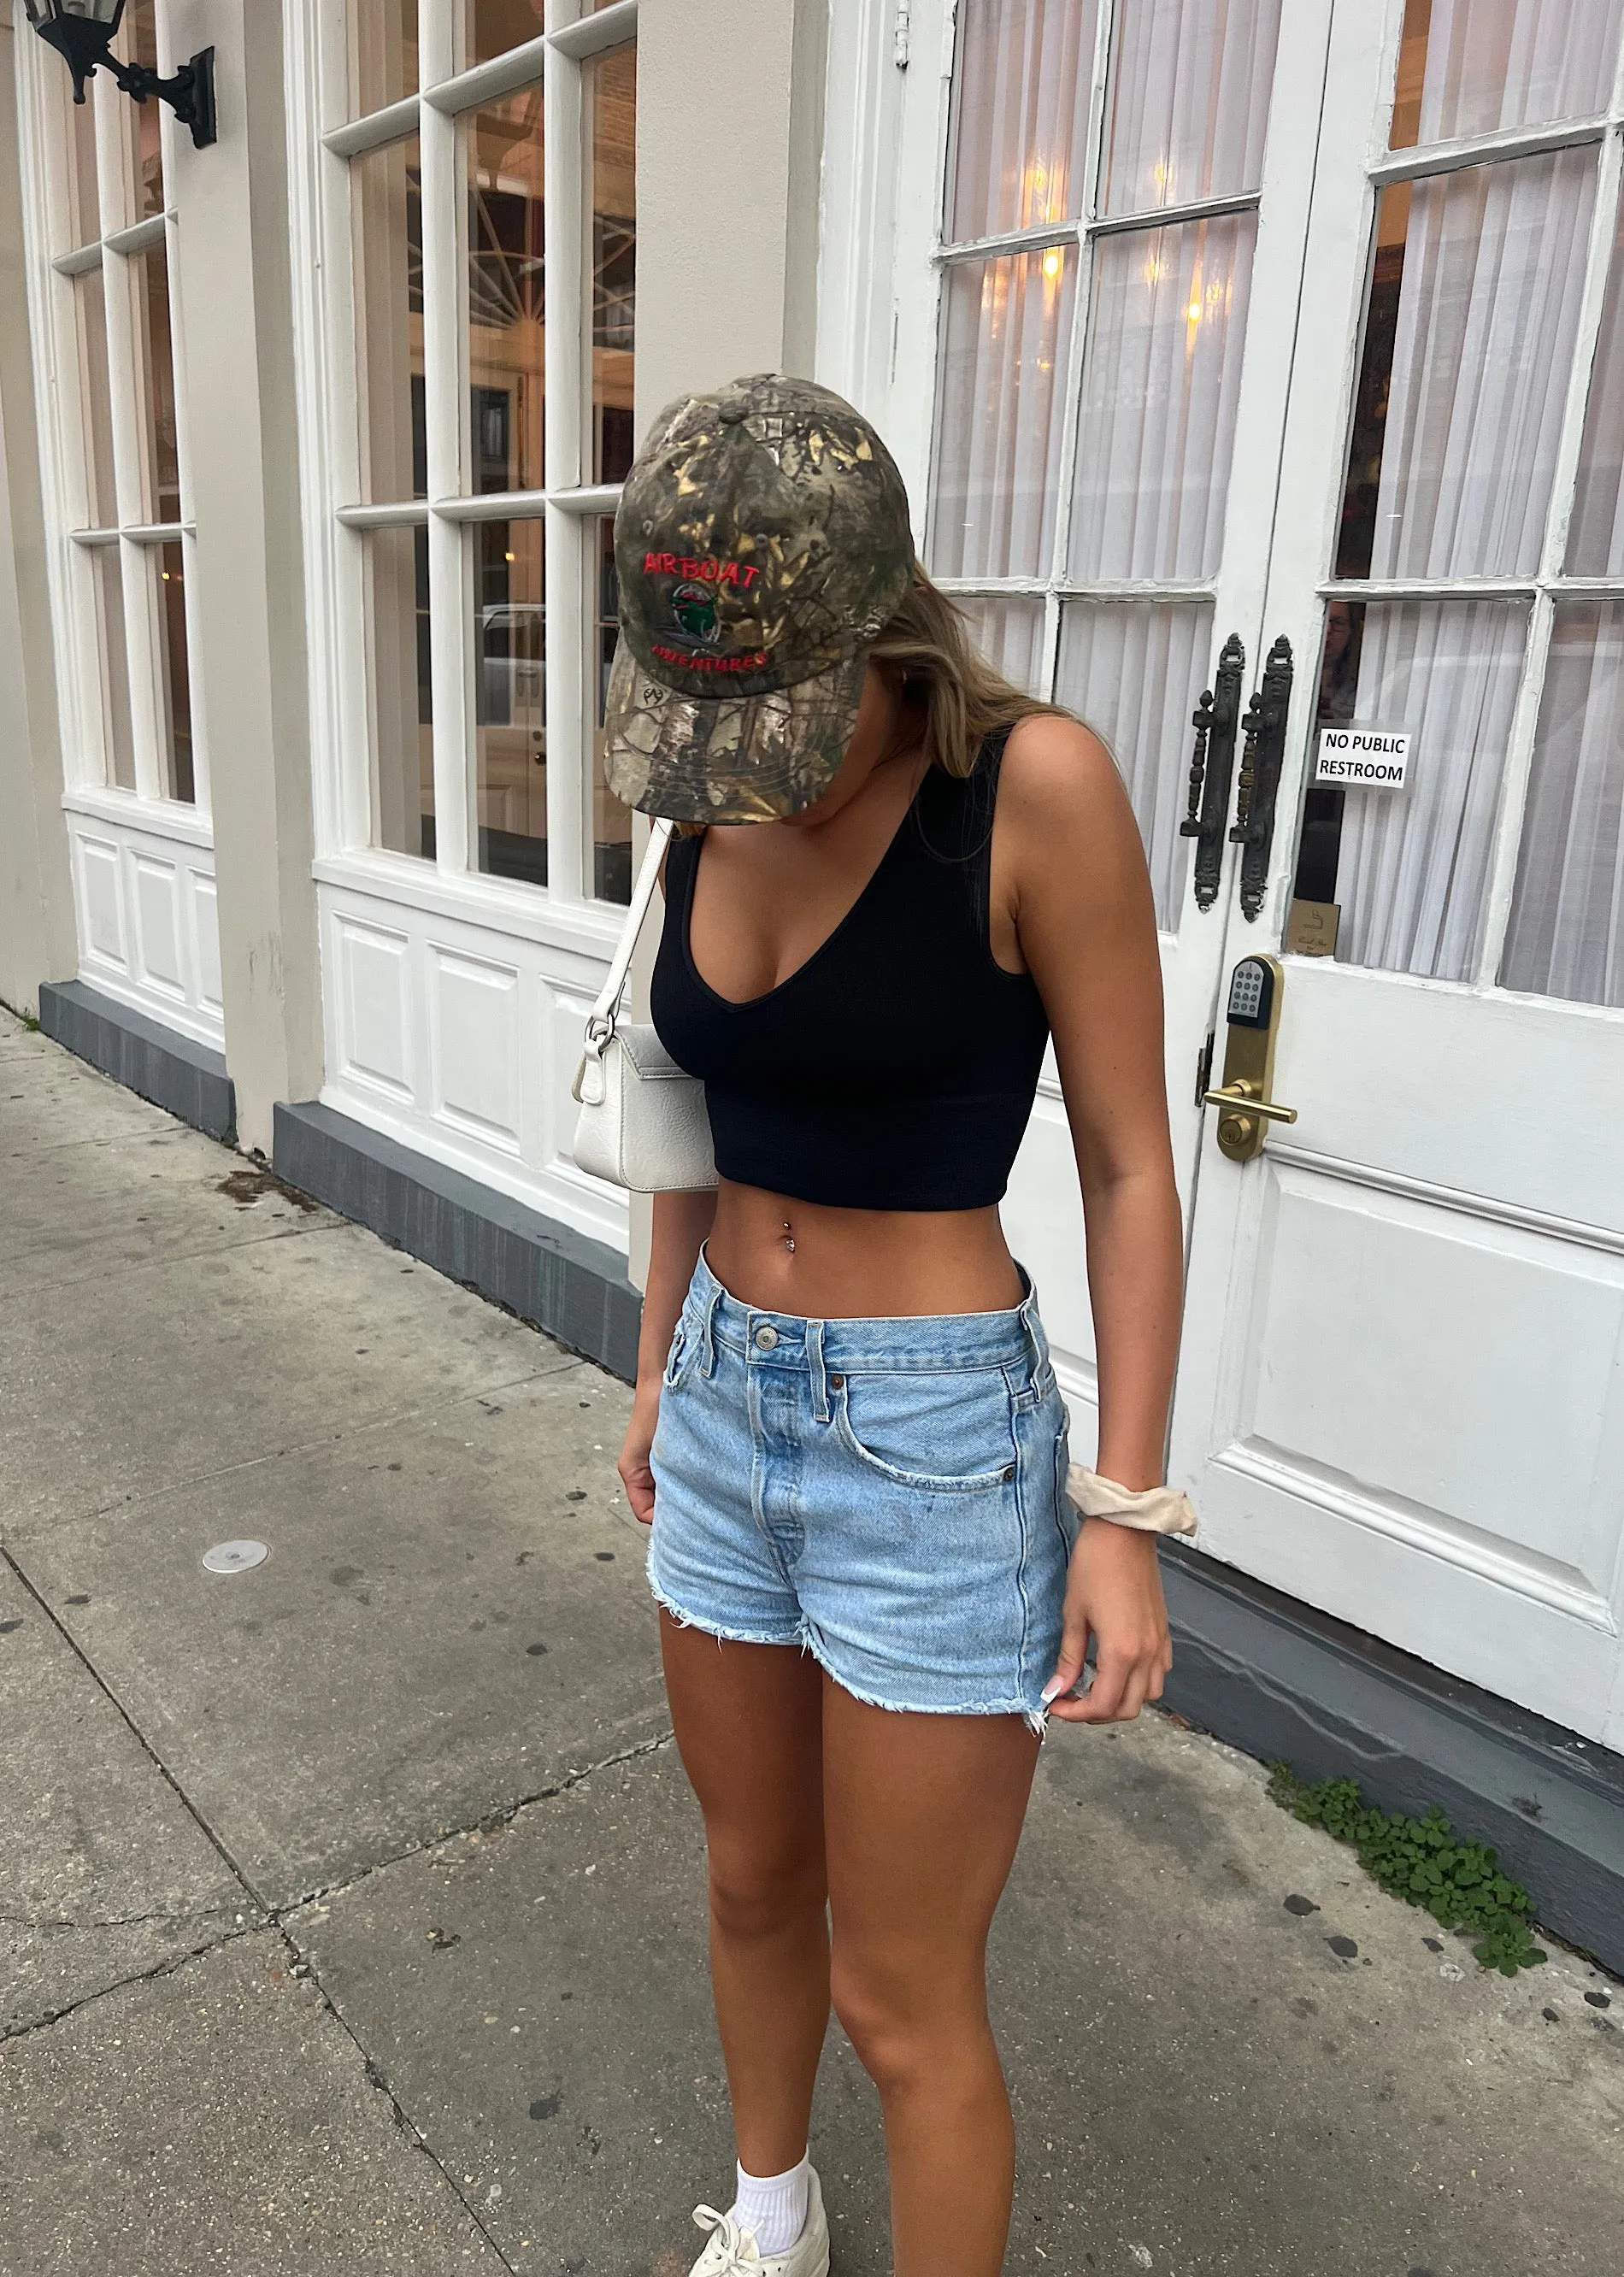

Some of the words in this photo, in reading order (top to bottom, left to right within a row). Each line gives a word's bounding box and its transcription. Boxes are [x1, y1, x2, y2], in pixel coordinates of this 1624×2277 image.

[644, 553, 759, 588] AIRBOAT
[1326, 733, 1349, 749] NO
[1352, 735, 1405, 754] PUBLIC
[1320, 759, 1403, 781] RESTROOM
